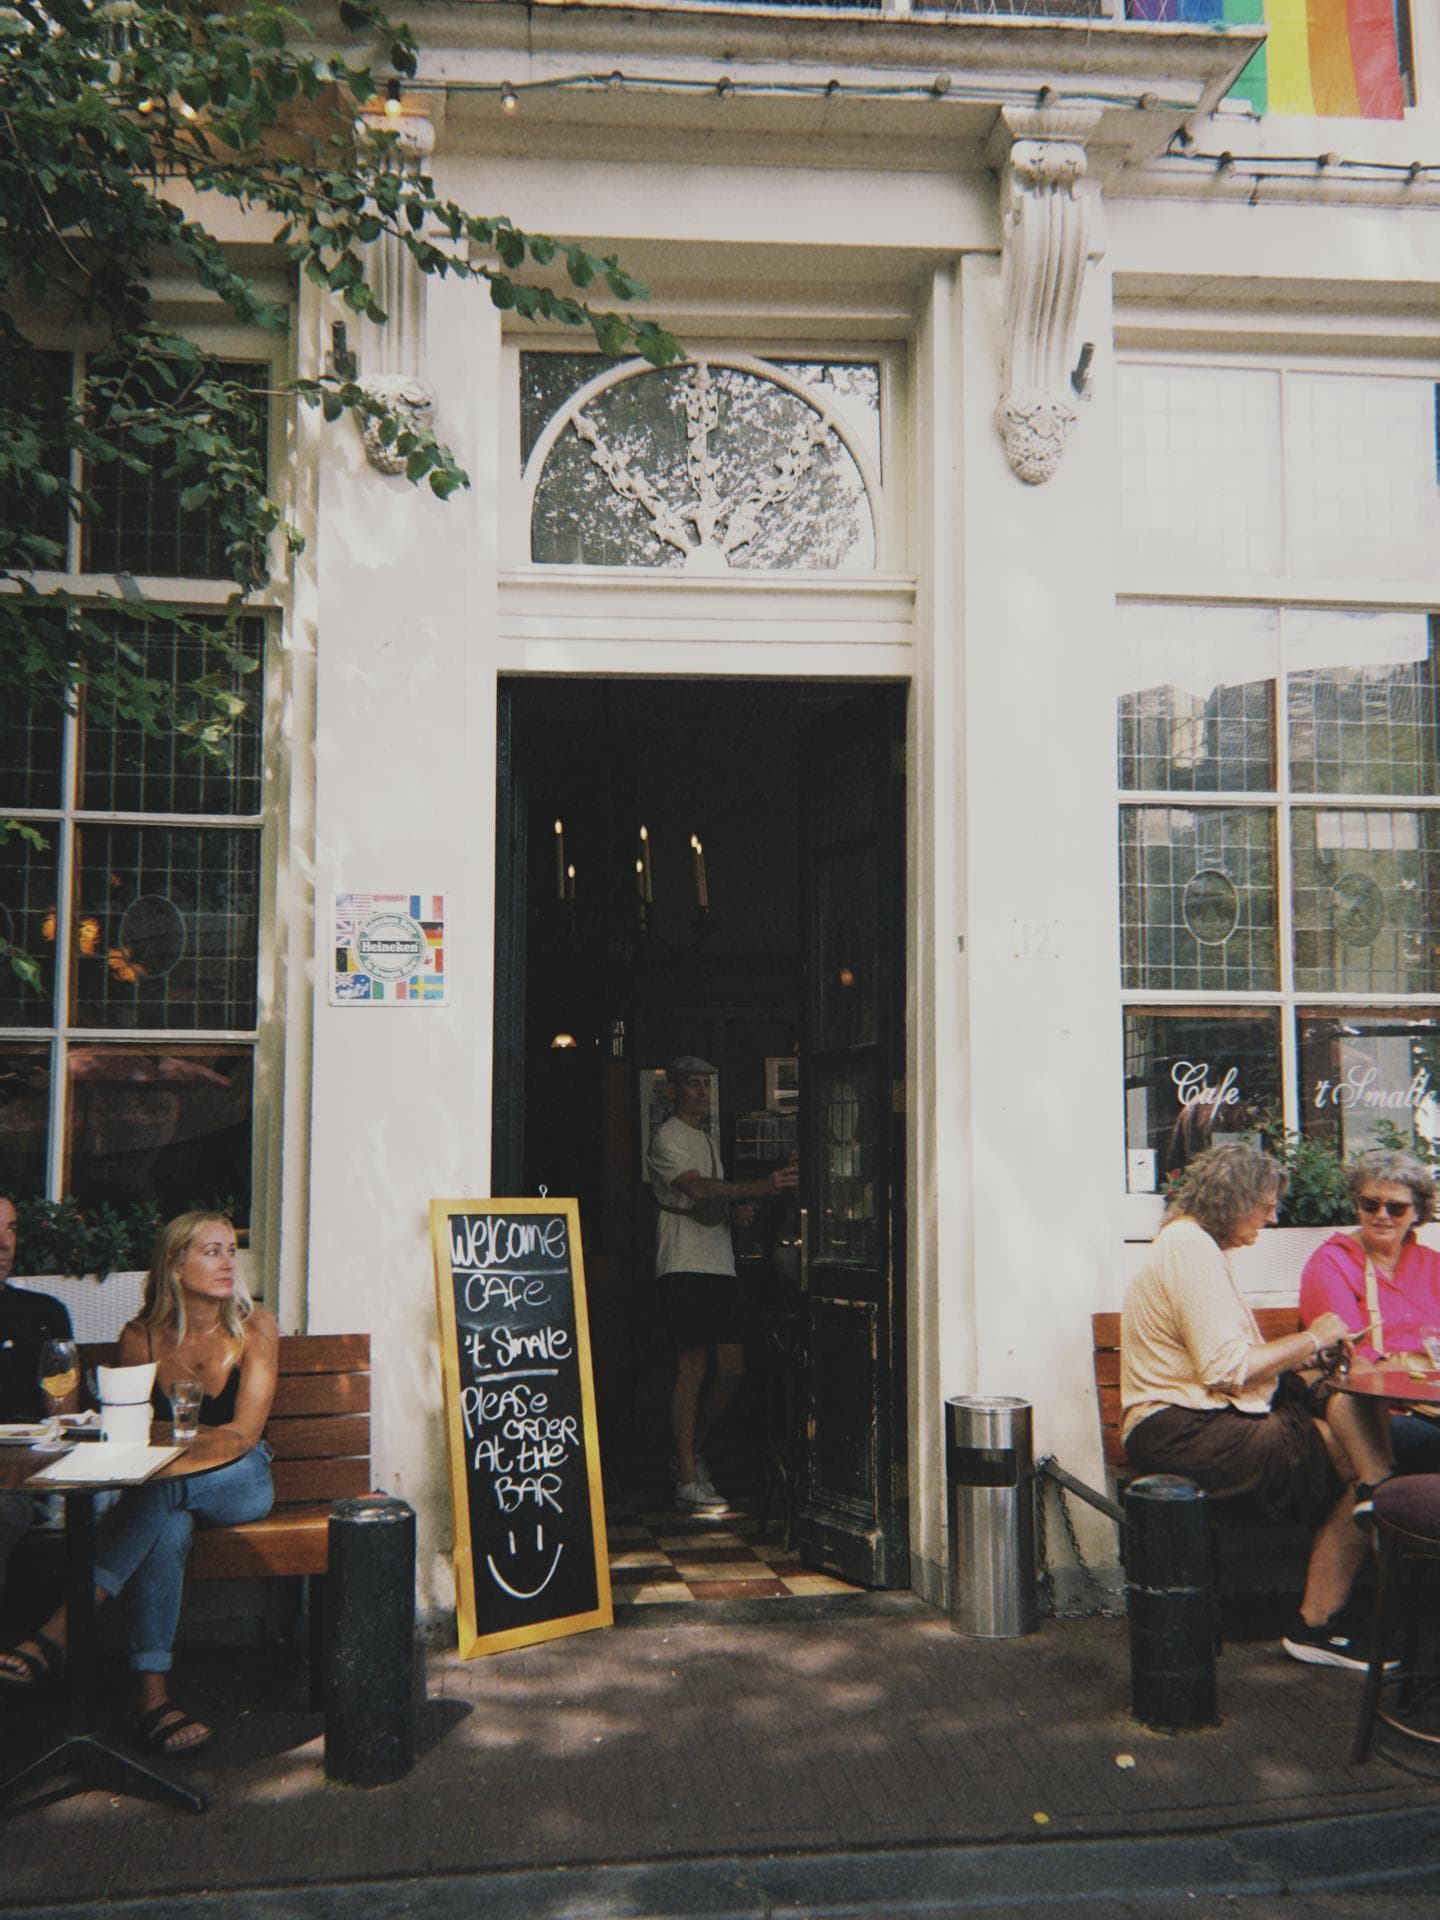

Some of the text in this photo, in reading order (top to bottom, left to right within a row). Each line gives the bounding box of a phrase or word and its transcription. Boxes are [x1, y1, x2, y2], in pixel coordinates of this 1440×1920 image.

[361, 941, 418, 953] Heineken
[449, 1215, 566, 1268] Welcome
[464, 1333, 492, 1369] 't
[494, 1473, 563, 1513] BAR
